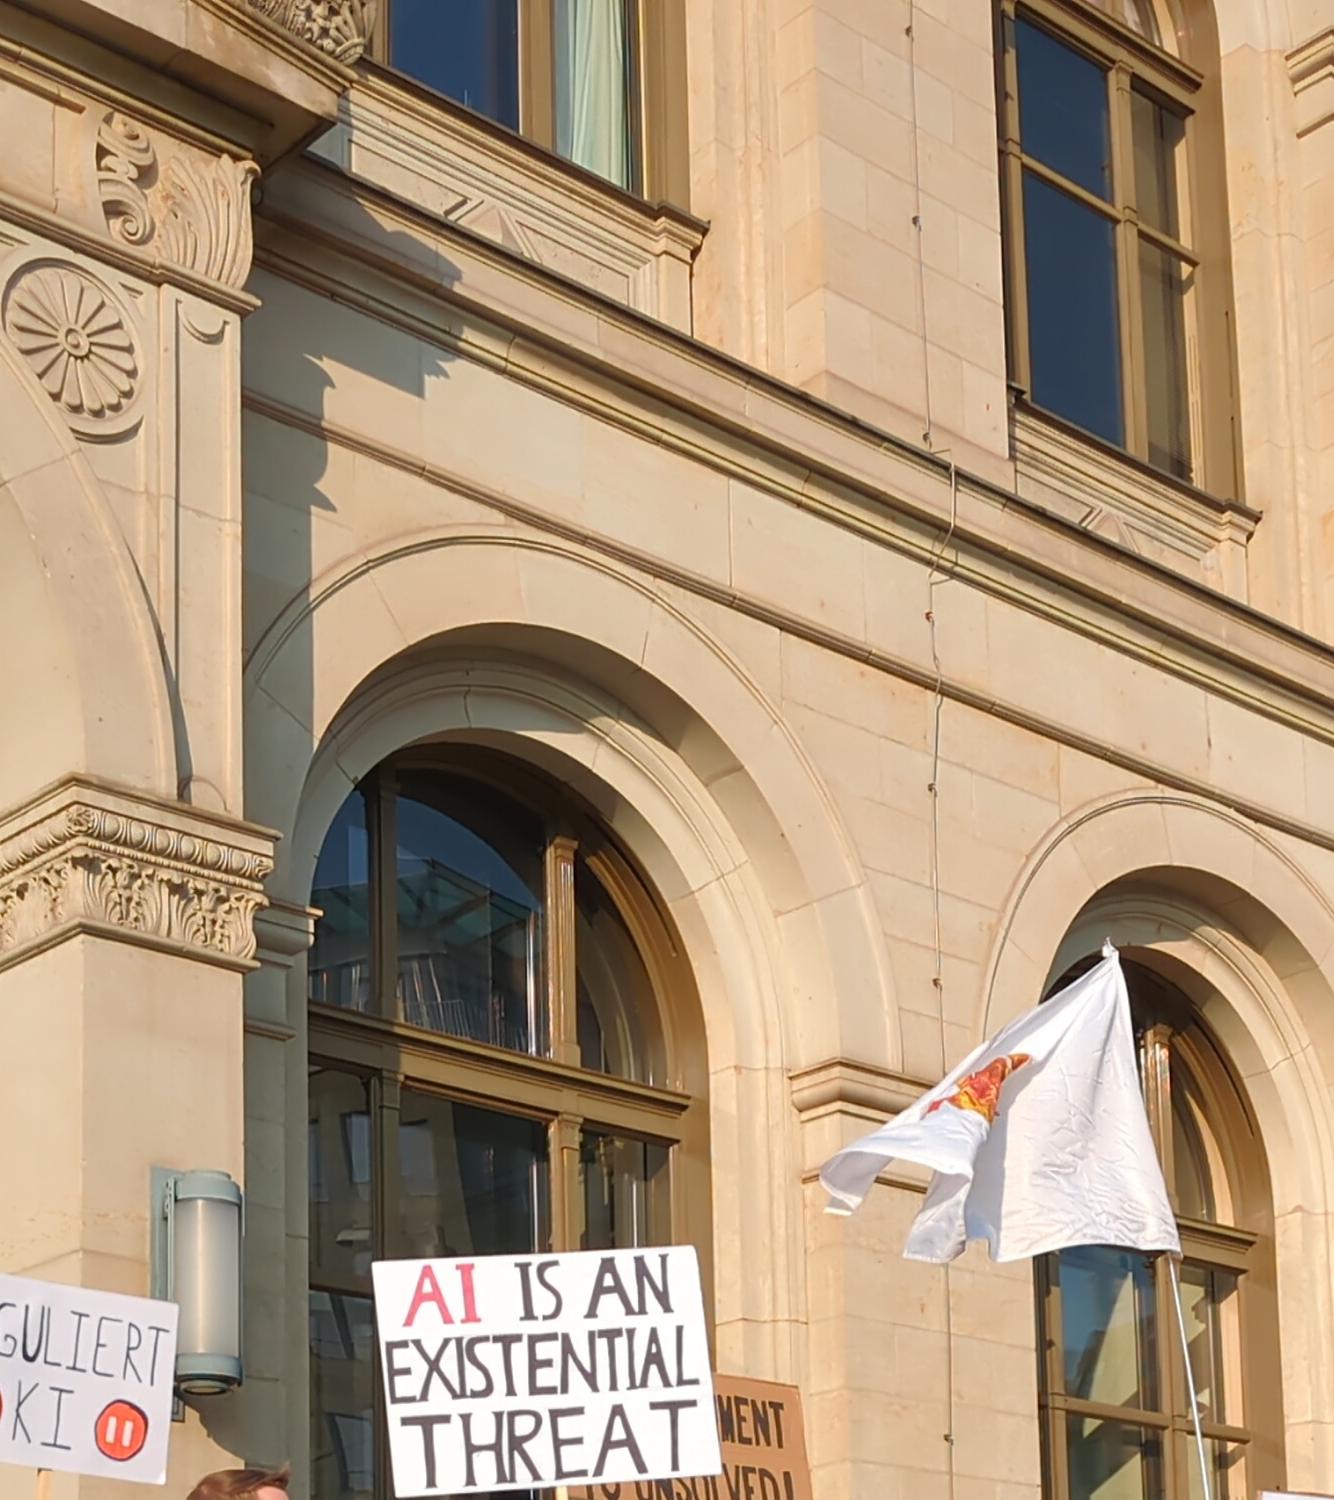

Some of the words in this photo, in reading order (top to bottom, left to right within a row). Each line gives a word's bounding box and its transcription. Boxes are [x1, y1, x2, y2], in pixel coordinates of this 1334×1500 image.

[402, 1264, 481, 1326] AI
[514, 1260, 564, 1321] IS
[584, 1254, 674, 1318] AN
[385, 1324, 701, 1405] EXISTENTIAL
[11, 1381, 75, 1452] KI
[399, 1398, 699, 1490] THREAT
